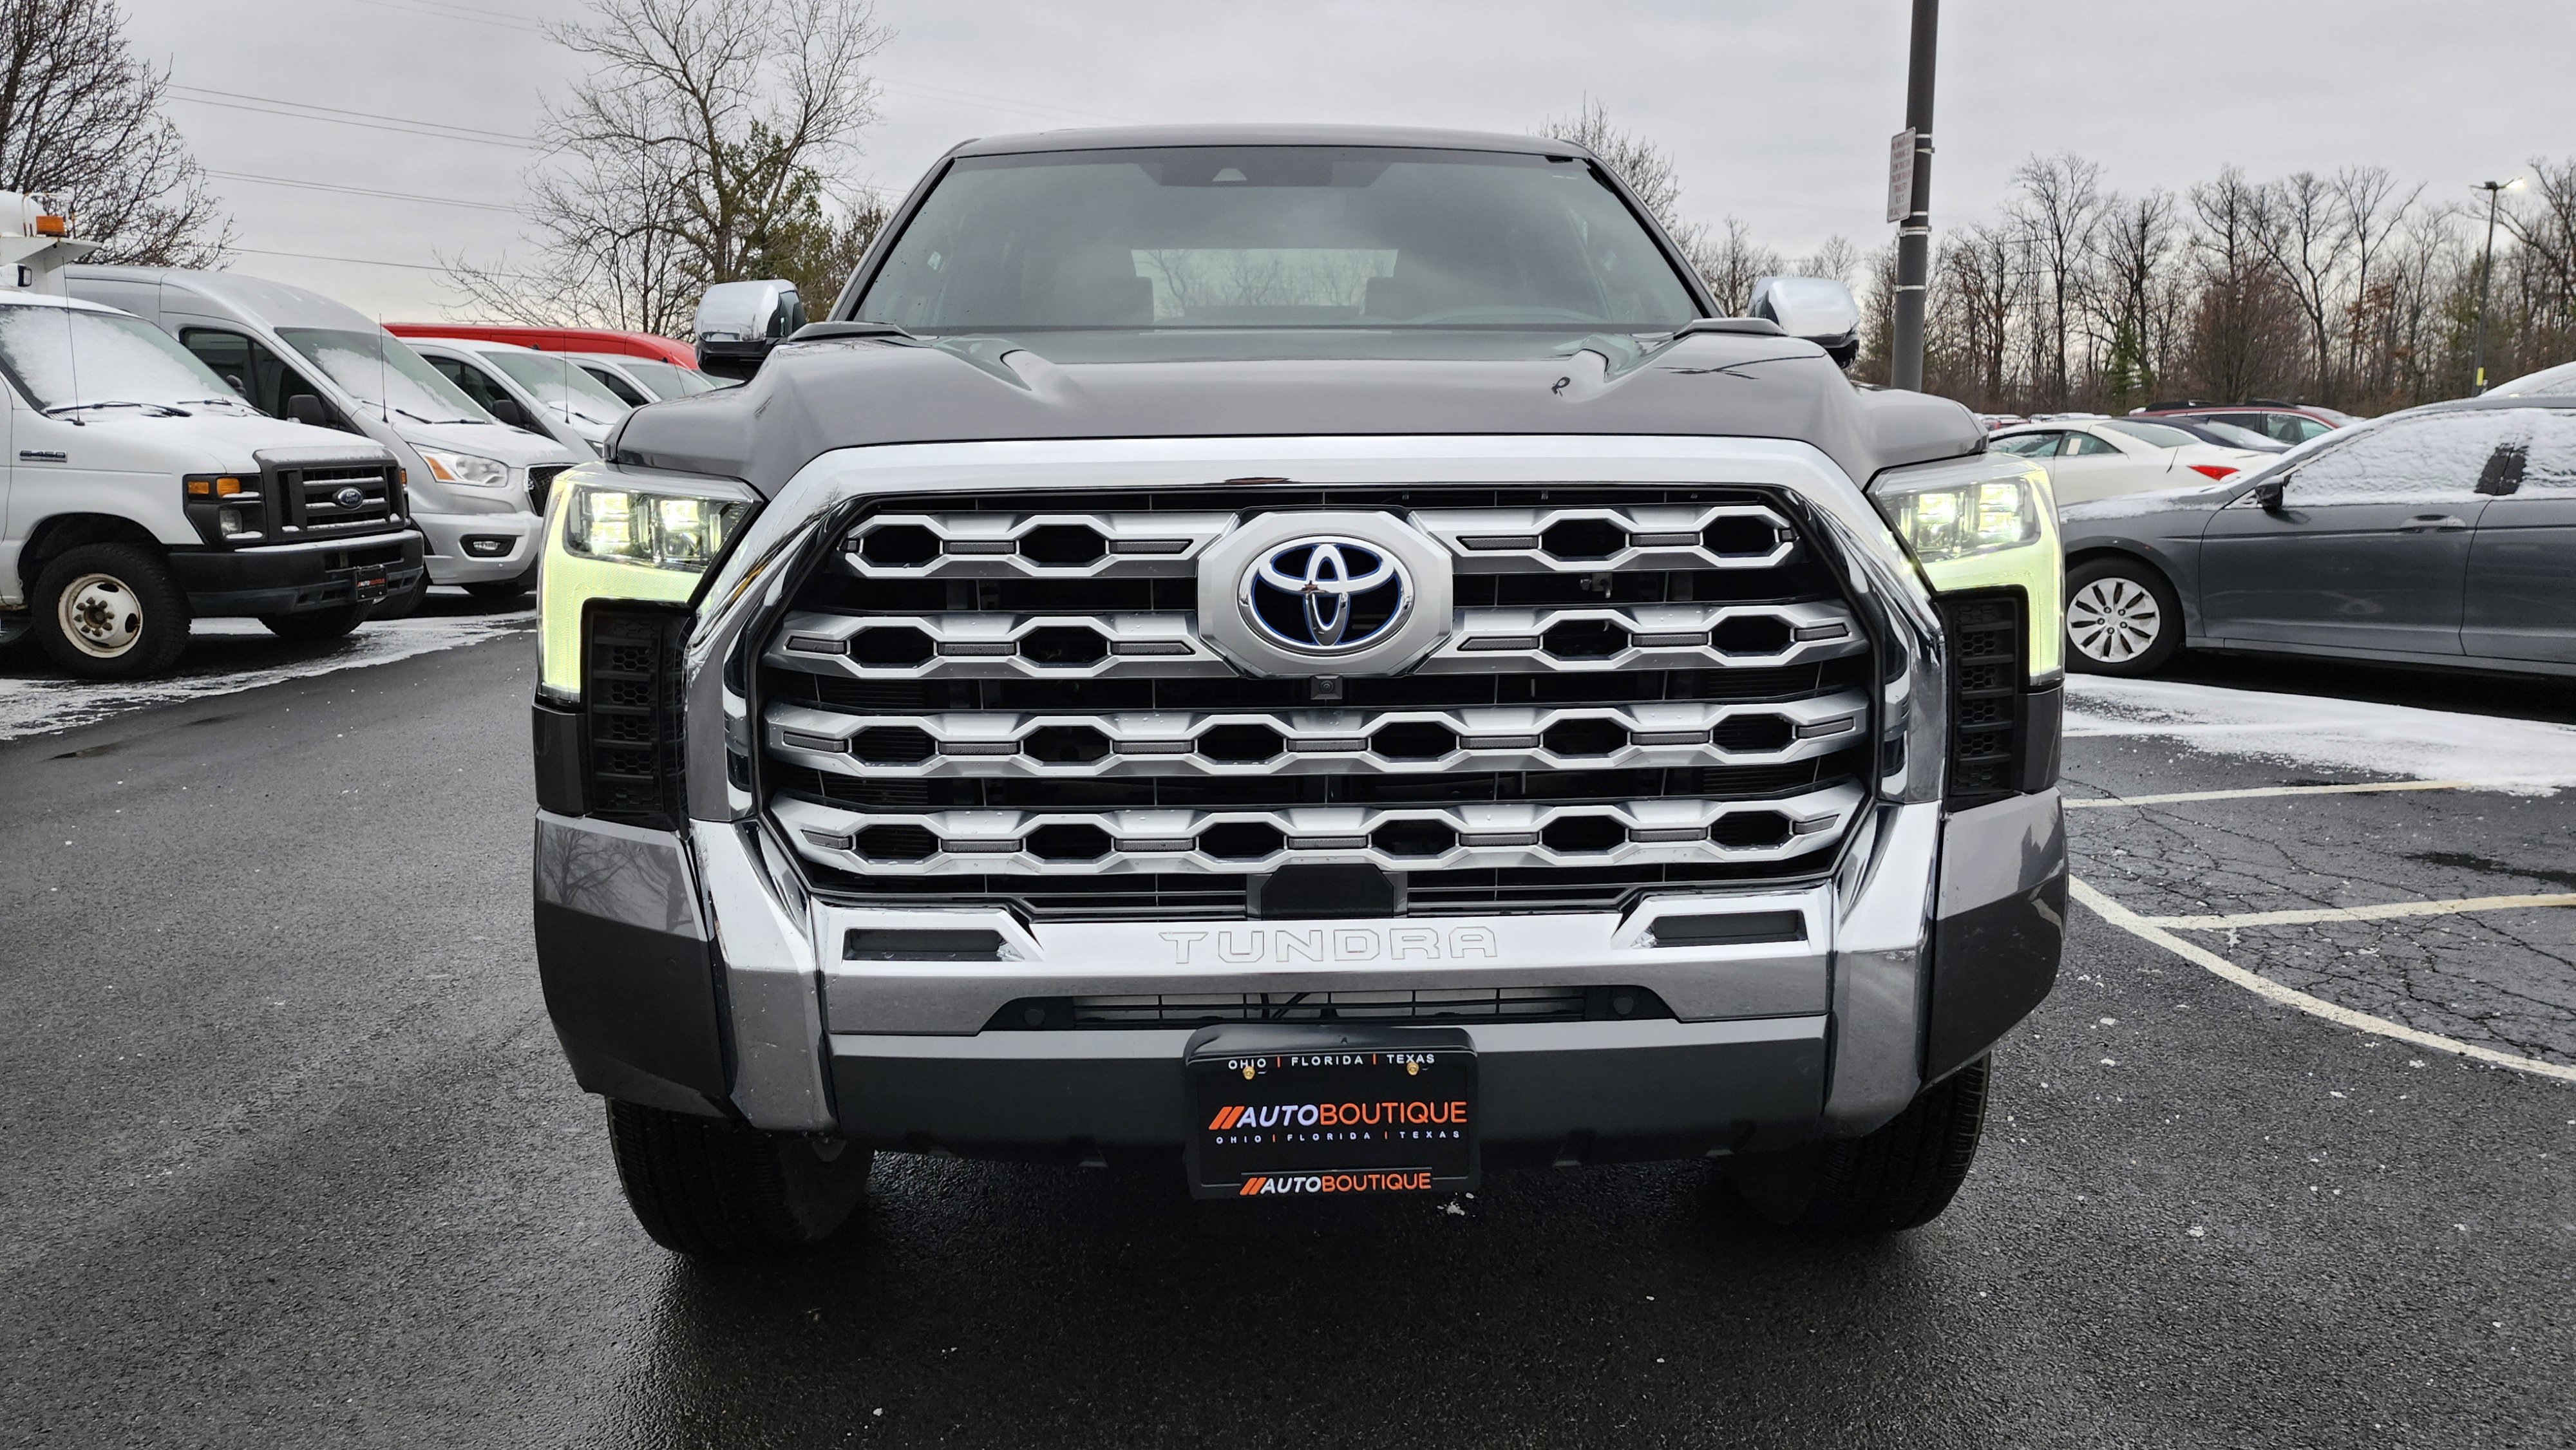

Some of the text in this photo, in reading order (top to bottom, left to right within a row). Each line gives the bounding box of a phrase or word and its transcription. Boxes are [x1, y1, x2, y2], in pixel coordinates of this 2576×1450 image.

[1158, 926, 1498, 965] TUNDRA
[1227, 1053, 1435, 1069] OHIO FLORIDA TEXAS
[1215, 1130, 1460, 1145] OHIO FLORIDA TEXAS
